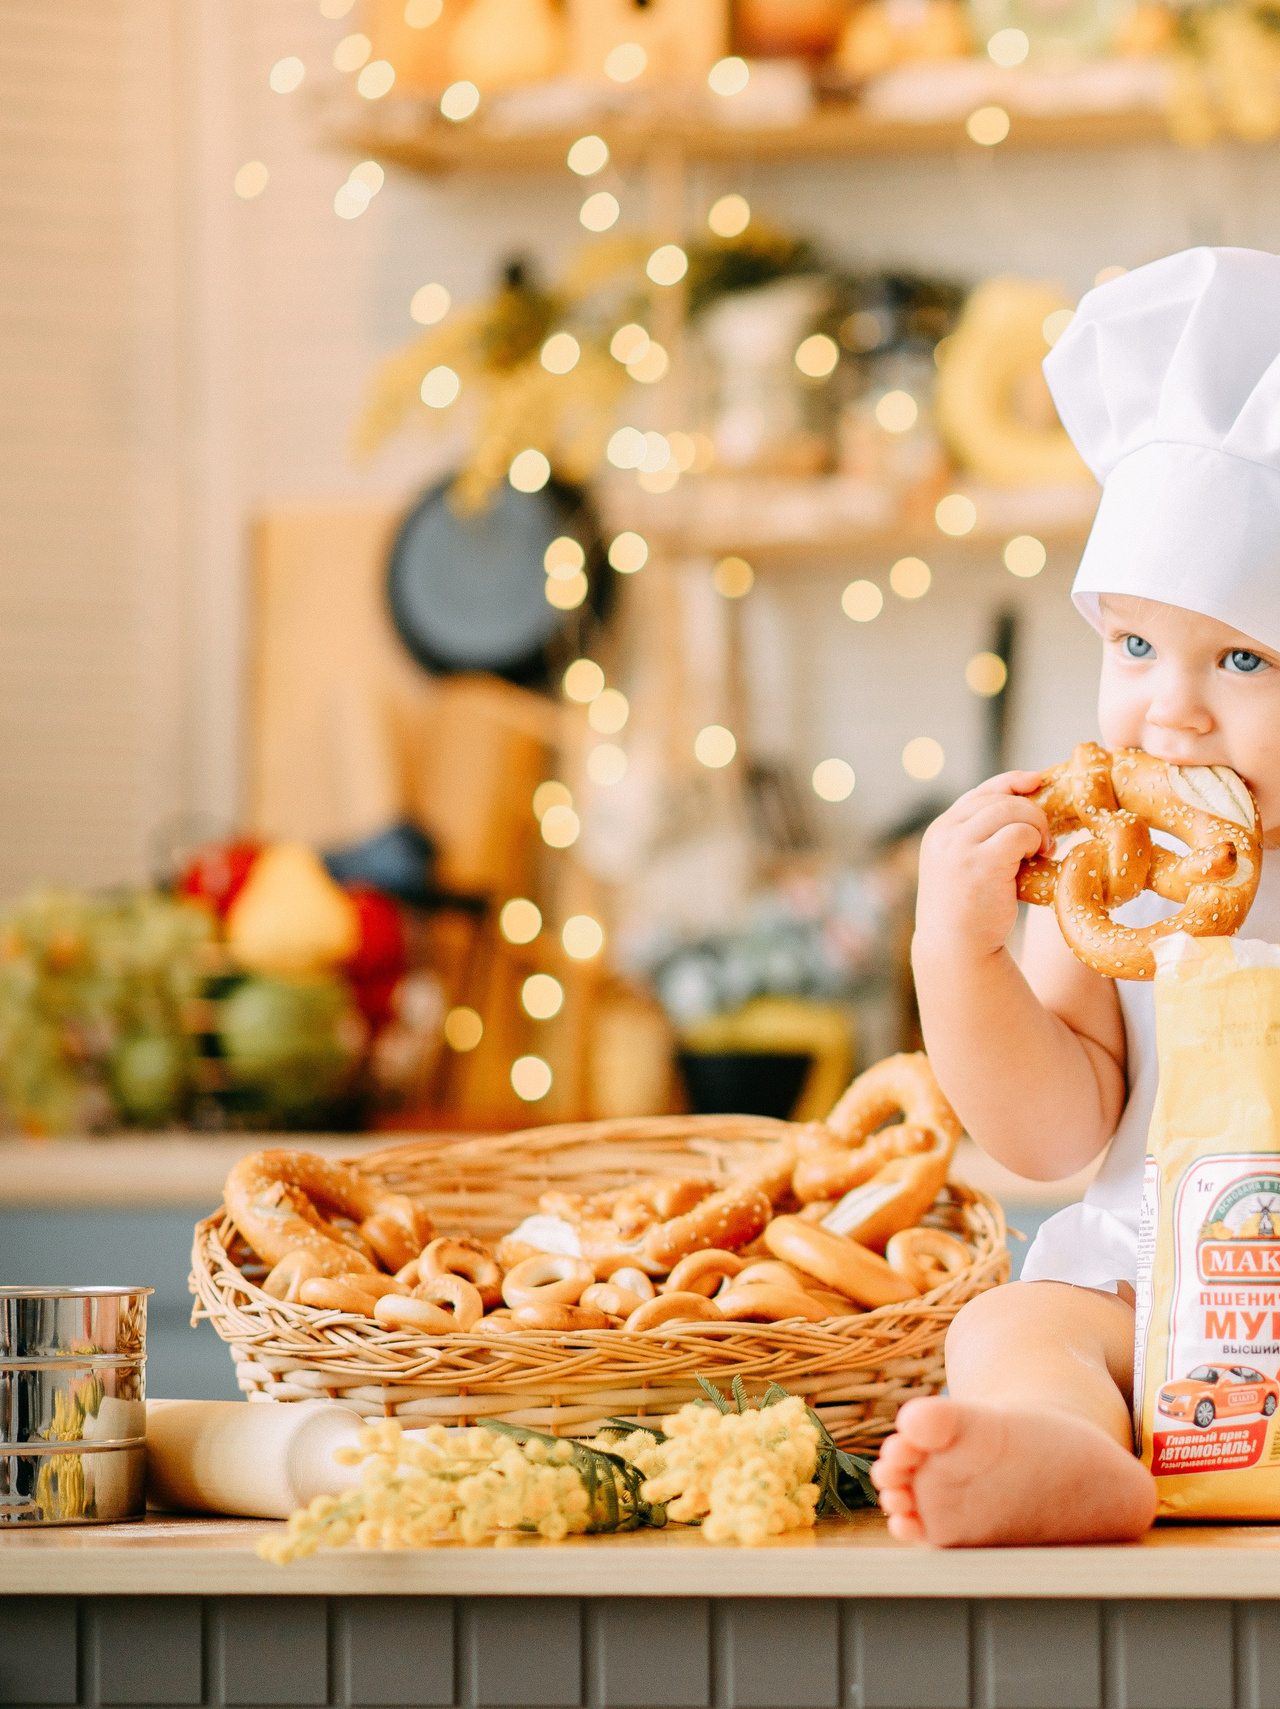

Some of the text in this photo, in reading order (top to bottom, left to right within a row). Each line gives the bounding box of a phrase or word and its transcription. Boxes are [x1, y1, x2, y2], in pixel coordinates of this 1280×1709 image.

[1219, 1181, 1262, 1213] ОСНОВАНА
[1263, 1181, 1271, 1190] В
[1223, 1344, 1280, 1355] ВЫСШИЙ
[1165, 1430, 1250, 1446] Главный приз
[1158, 1439, 1257, 1461] АВТОМОБИЛЬ!
